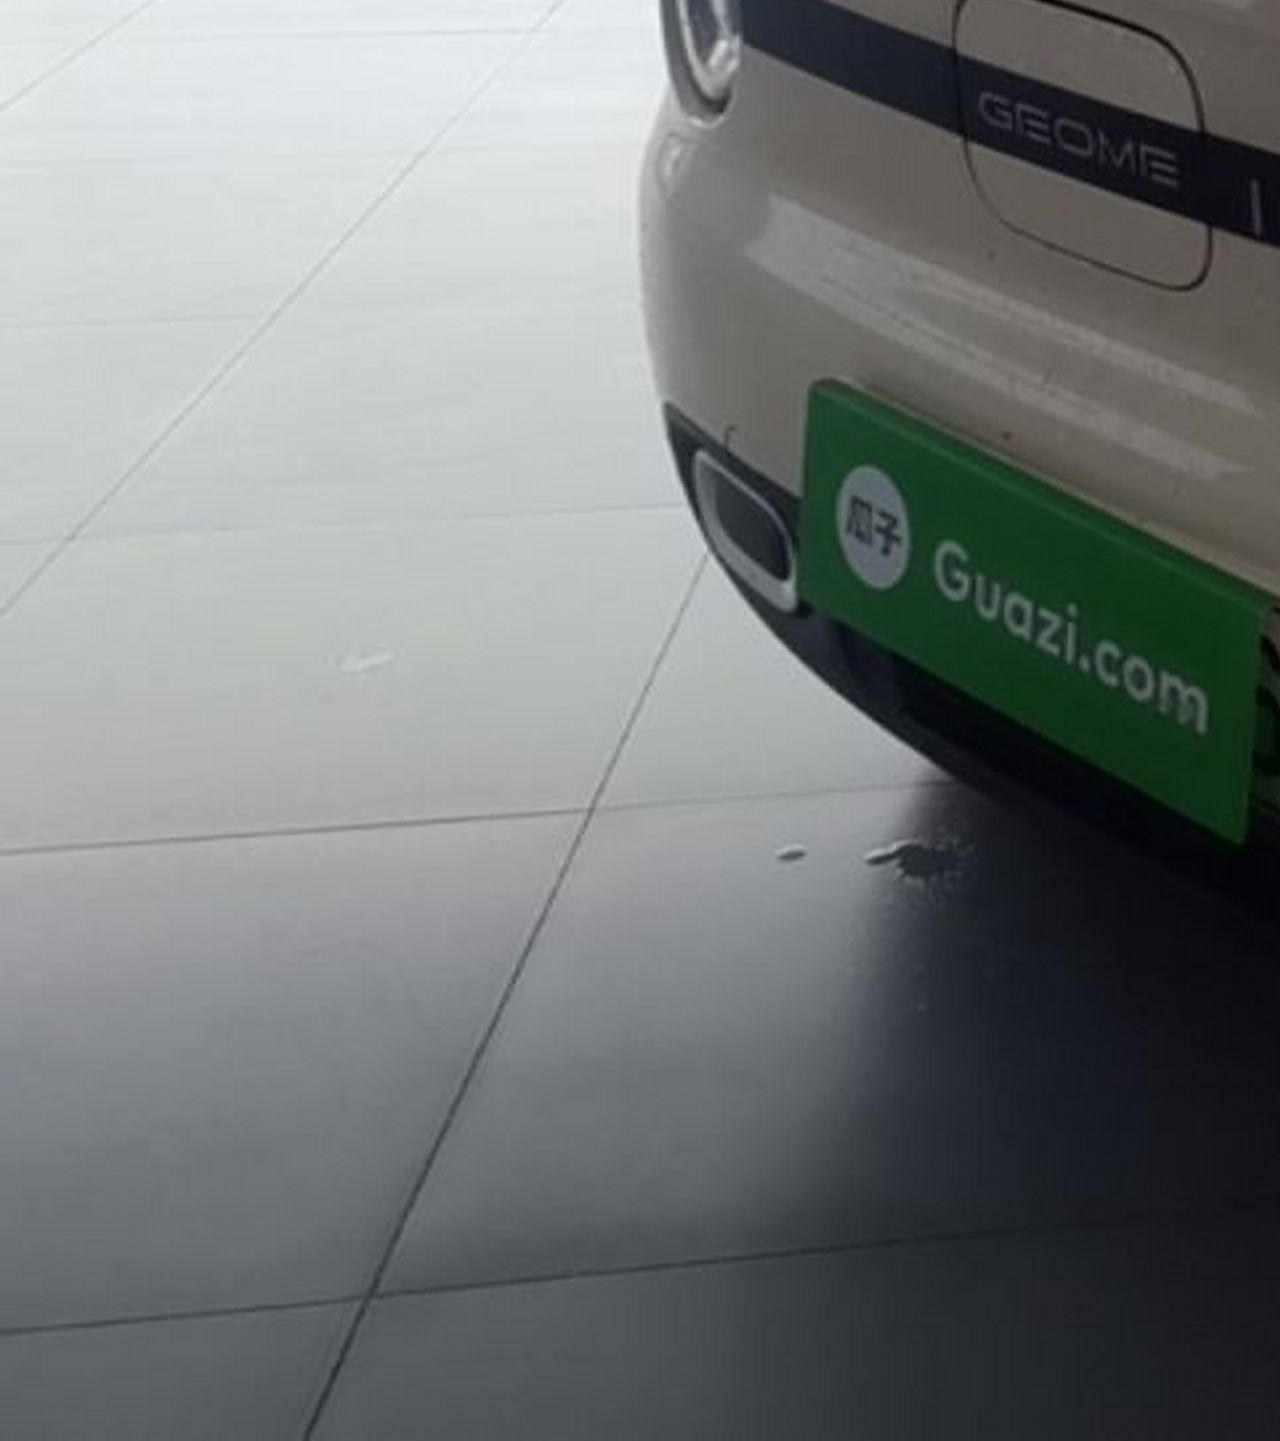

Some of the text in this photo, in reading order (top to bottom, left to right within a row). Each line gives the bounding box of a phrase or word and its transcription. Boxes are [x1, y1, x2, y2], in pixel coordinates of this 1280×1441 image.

[979, 90, 1180, 189] GEOME
[846, 494, 902, 558] 瓜子
[933, 539, 1209, 735] Guazi.com
